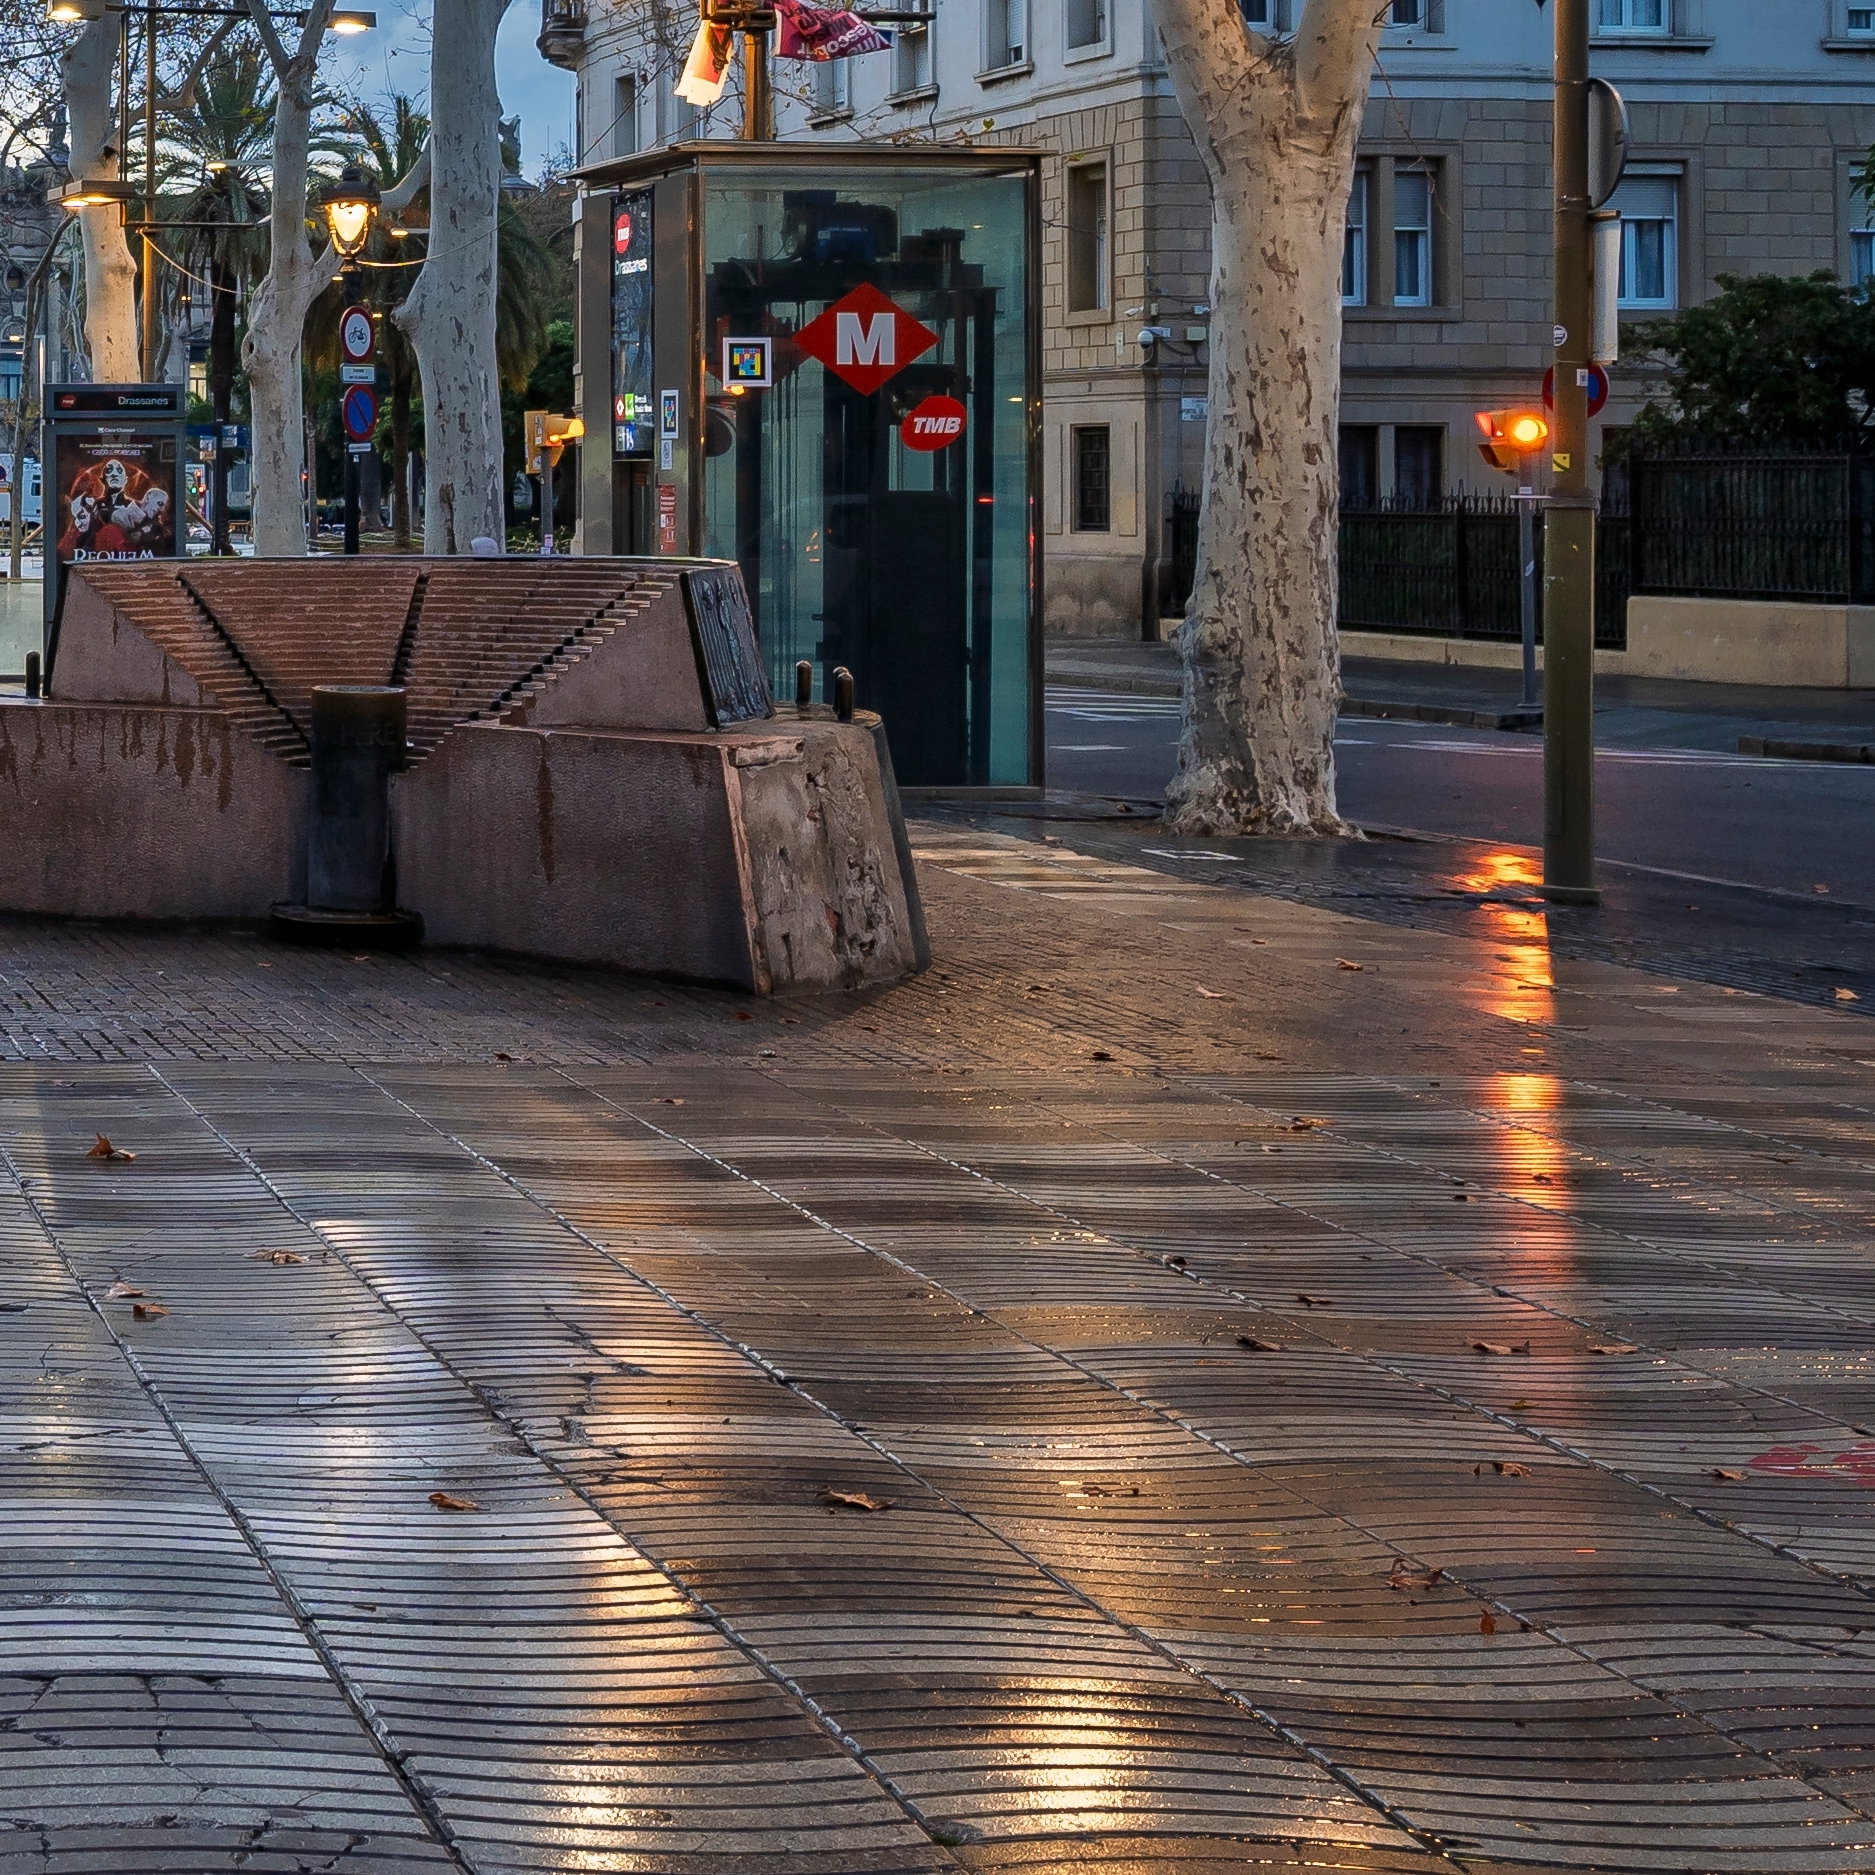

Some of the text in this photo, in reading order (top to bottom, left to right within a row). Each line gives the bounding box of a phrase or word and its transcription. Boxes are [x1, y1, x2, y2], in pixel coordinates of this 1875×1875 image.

[836, 312, 895, 365] M
[118, 396, 169, 405] Drassanes
[914, 417, 961, 434] TMB
